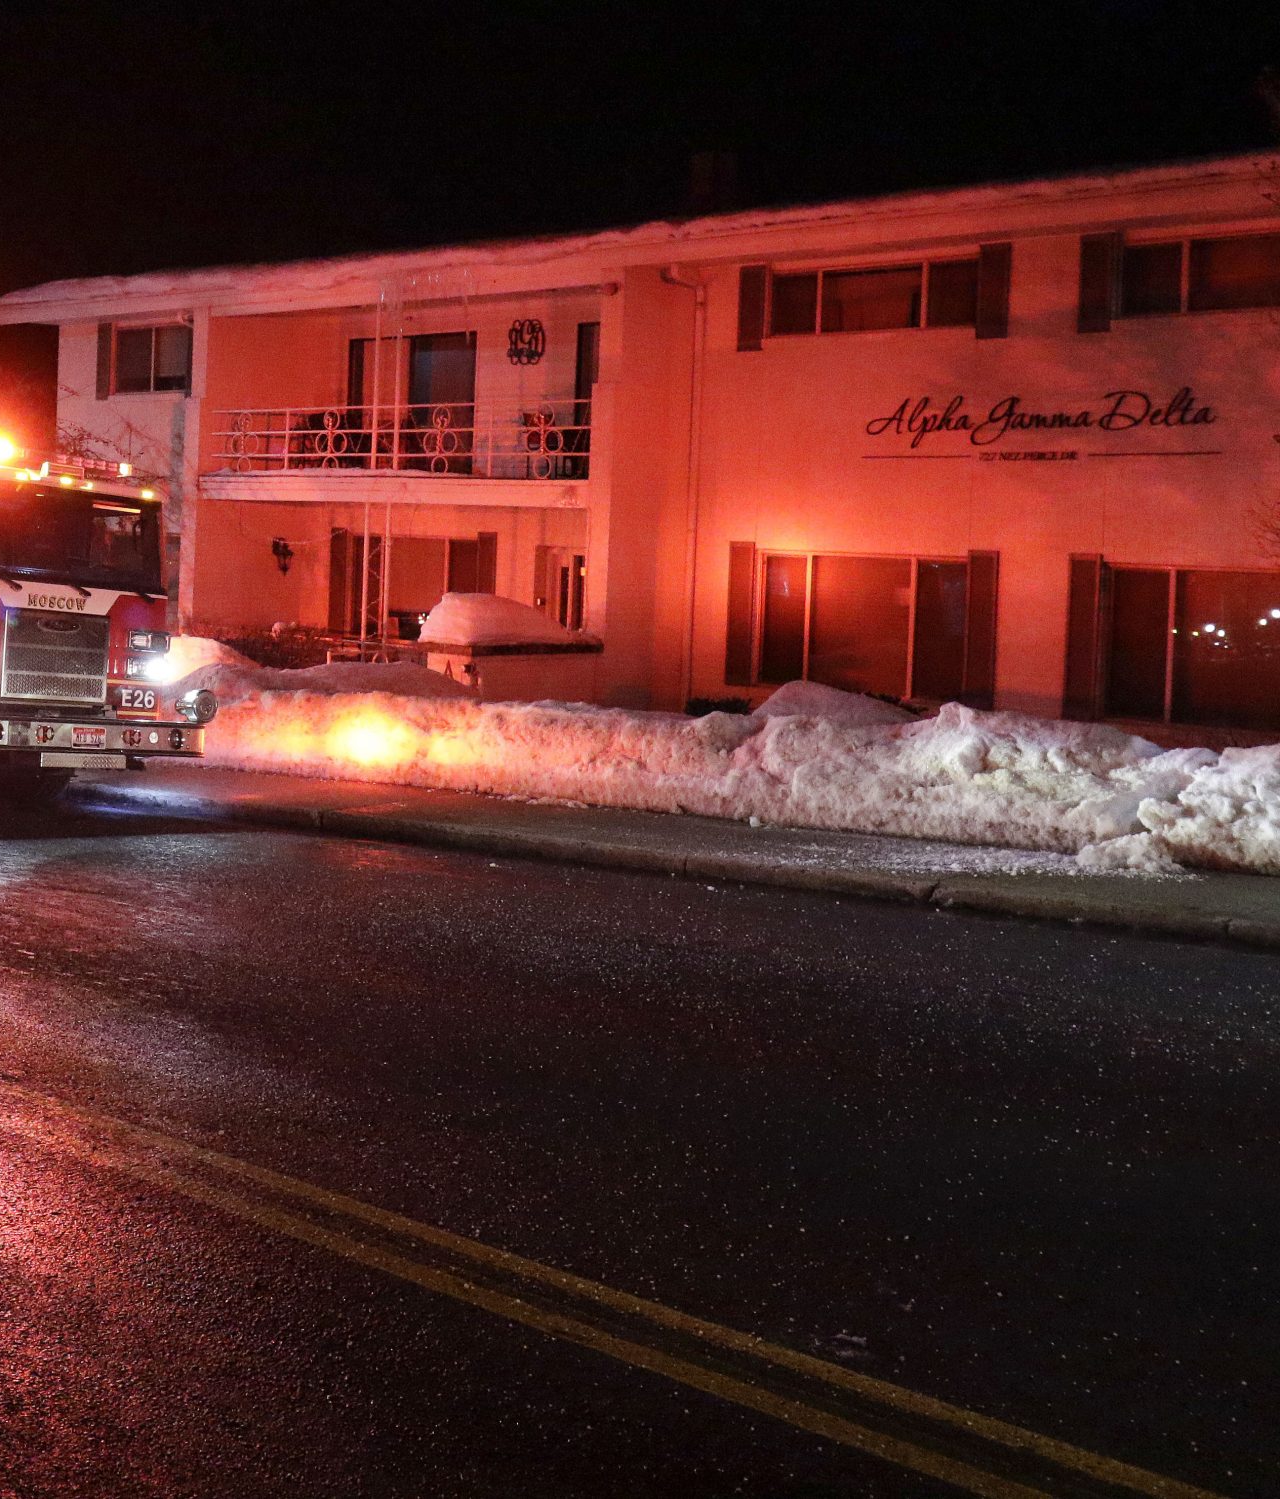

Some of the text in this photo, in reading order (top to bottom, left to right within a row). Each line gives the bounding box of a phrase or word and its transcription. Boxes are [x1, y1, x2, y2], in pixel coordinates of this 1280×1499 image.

[866, 386, 1216, 448] Alpha Gamma Delta
[27, 593, 87, 611] MOSCOW
[121, 689, 155, 709] E26
